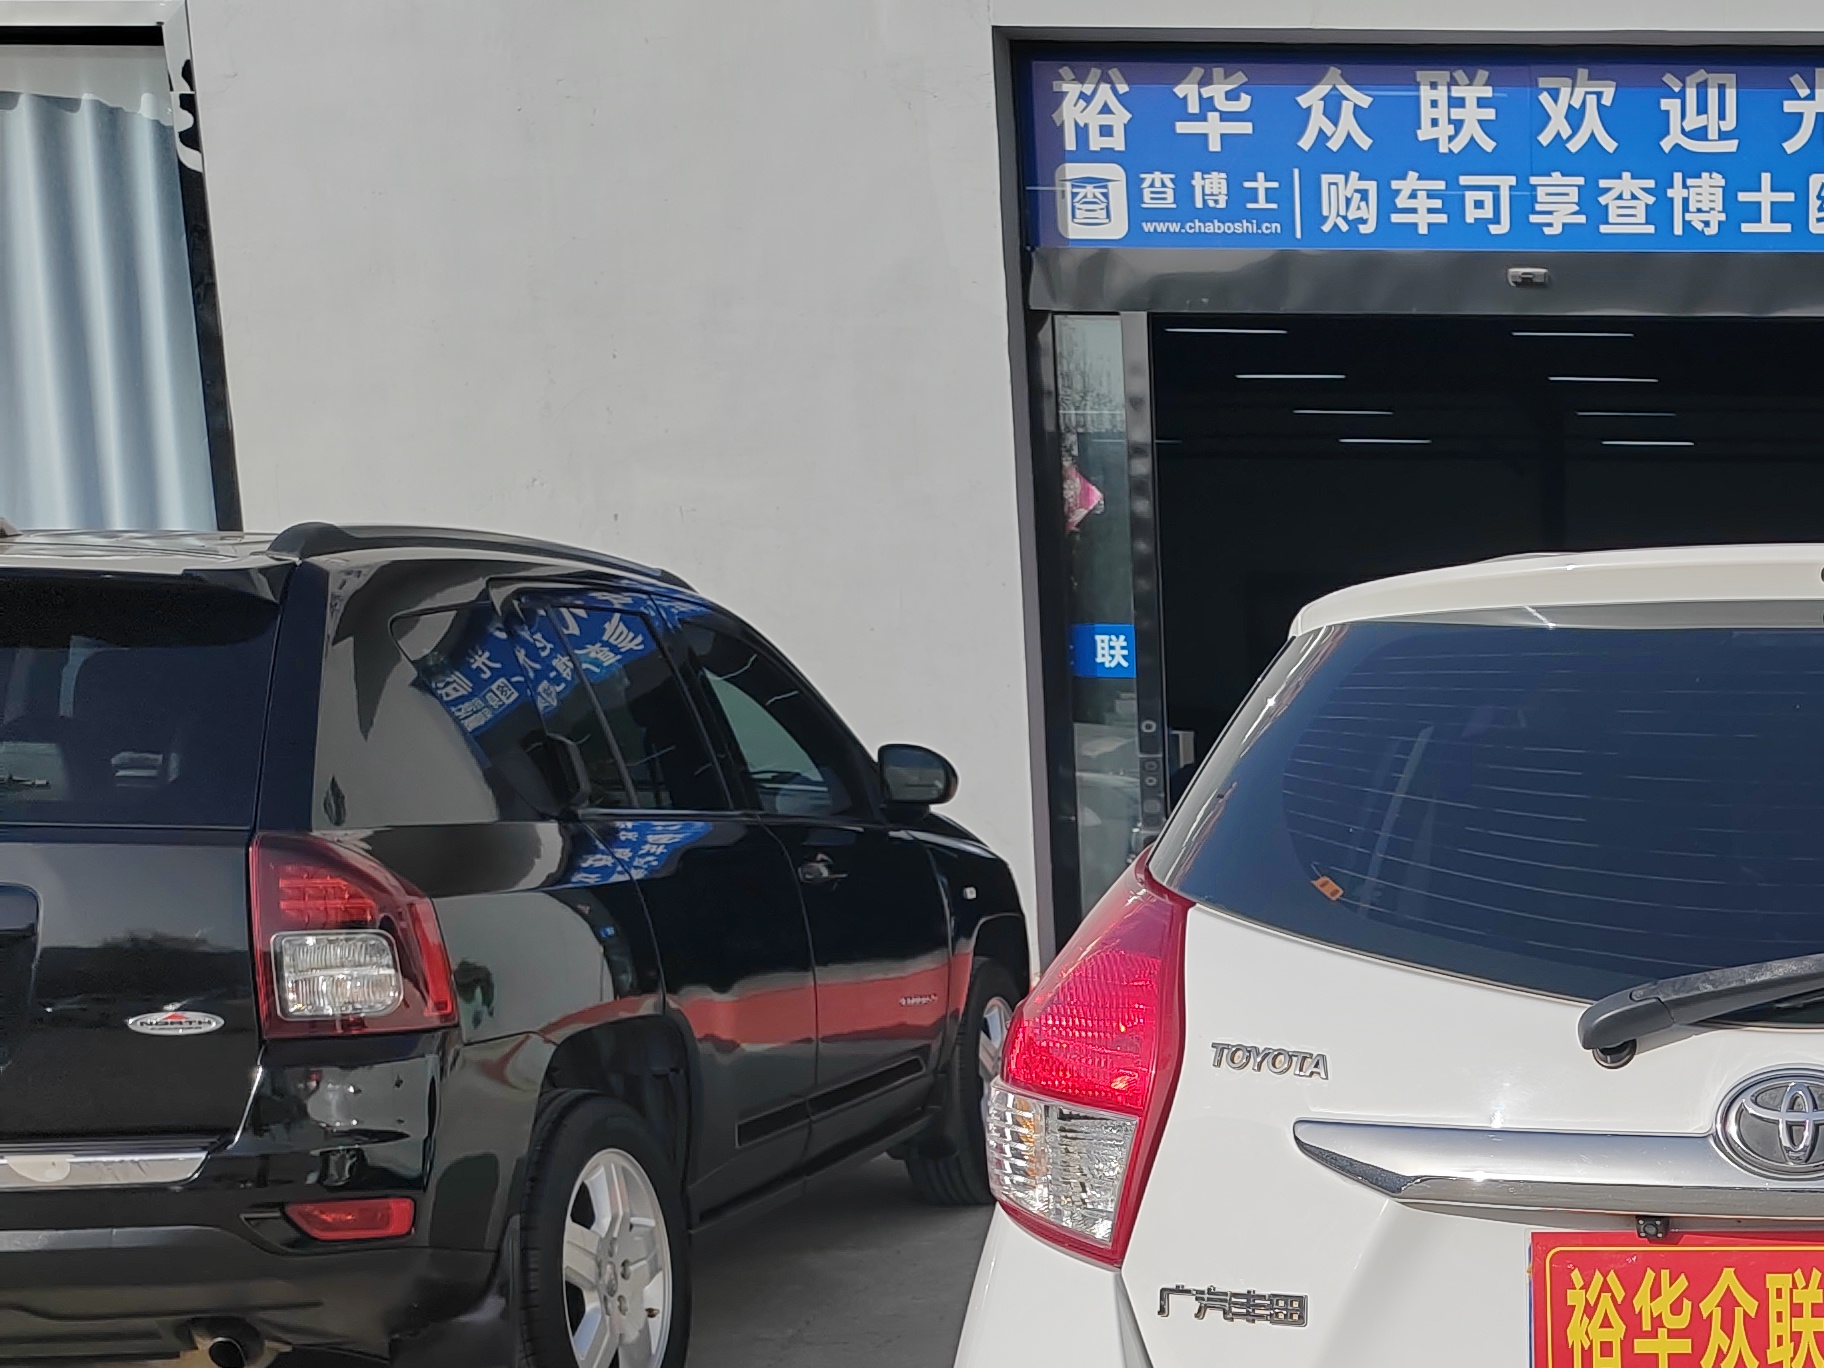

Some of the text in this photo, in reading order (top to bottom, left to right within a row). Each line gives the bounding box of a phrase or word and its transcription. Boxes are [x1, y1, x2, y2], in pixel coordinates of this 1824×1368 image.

[1139, 171, 1280, 210] 查博士
[1141, 218, 1282, 235] www.chaboshi.cn
[1094, 634, 1130, 668] 联
[1211, 1042, 1329, 1080] TOYOTA
[1157, 1284, 1308, 1327] 广汽丰田
